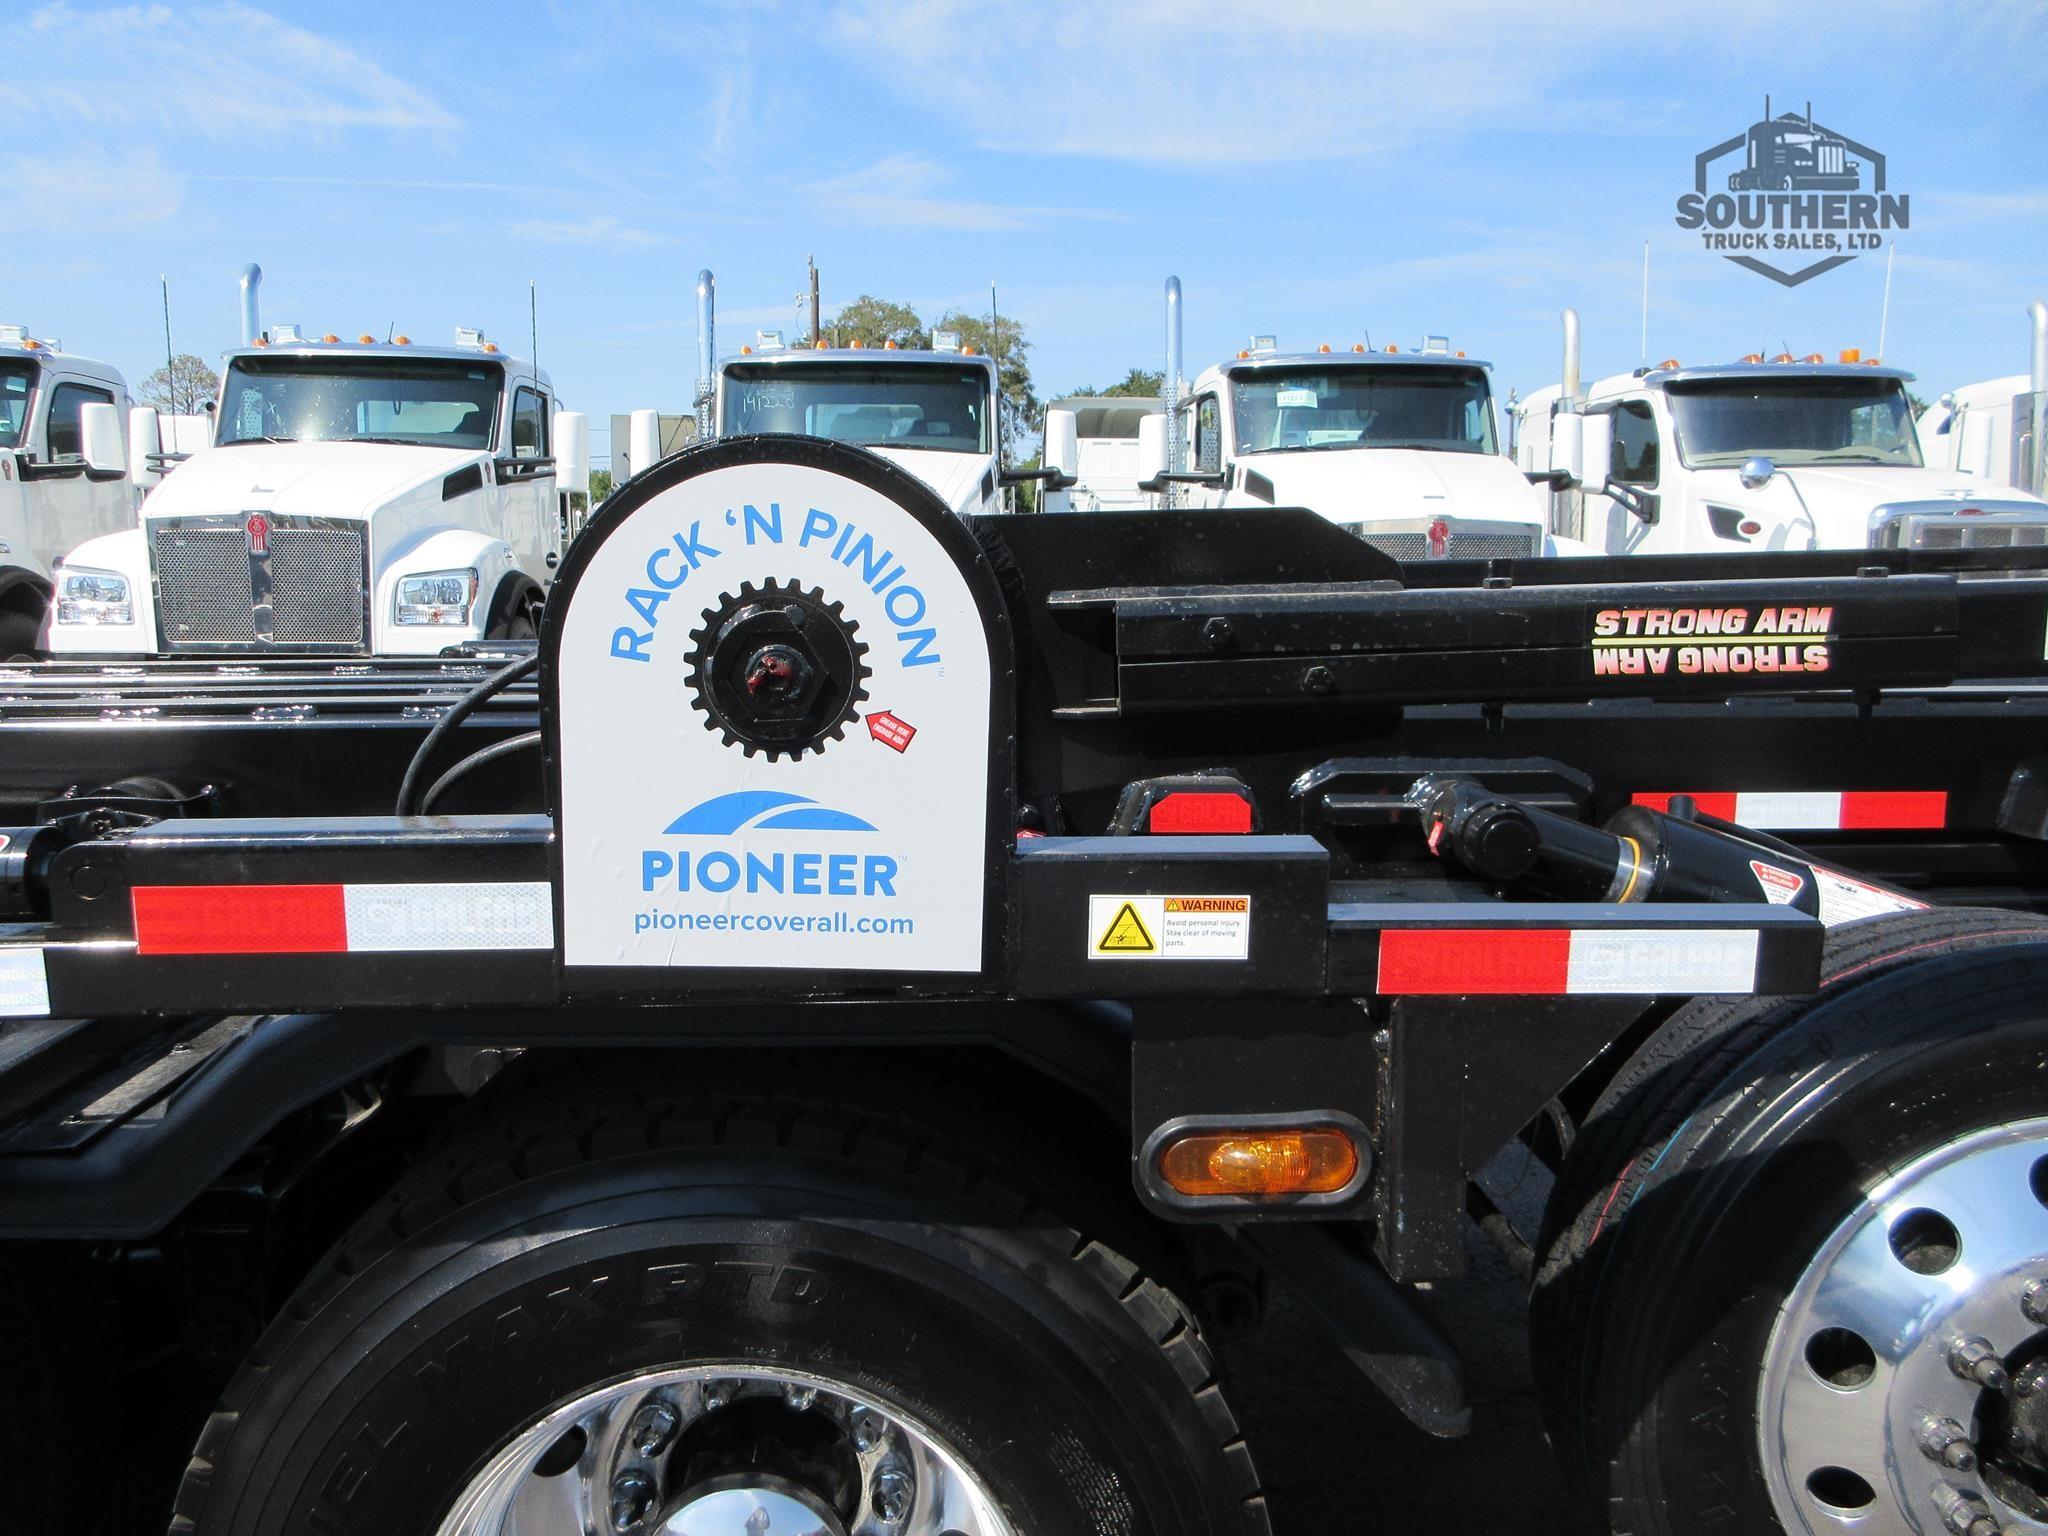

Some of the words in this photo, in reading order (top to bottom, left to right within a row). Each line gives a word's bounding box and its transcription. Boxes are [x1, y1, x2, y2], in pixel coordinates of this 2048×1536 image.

[610, 520, 722, 663] RACK
[798, 508, 941, 668] PINION
[1594, 608, 1748, 635] STRONG
[1752, 607, 1833, 634] ARM
[1593, 647, 1670, 675] ARM
[1678, 645, 1829, 674] STRONG
[642, 850, 898, 896] PIONEER
[1181, 900, 1246, 911] WARNING
[634, 907, 914, 934] pioneercoverall.com
[1188, 919, 1218, 927] personal
